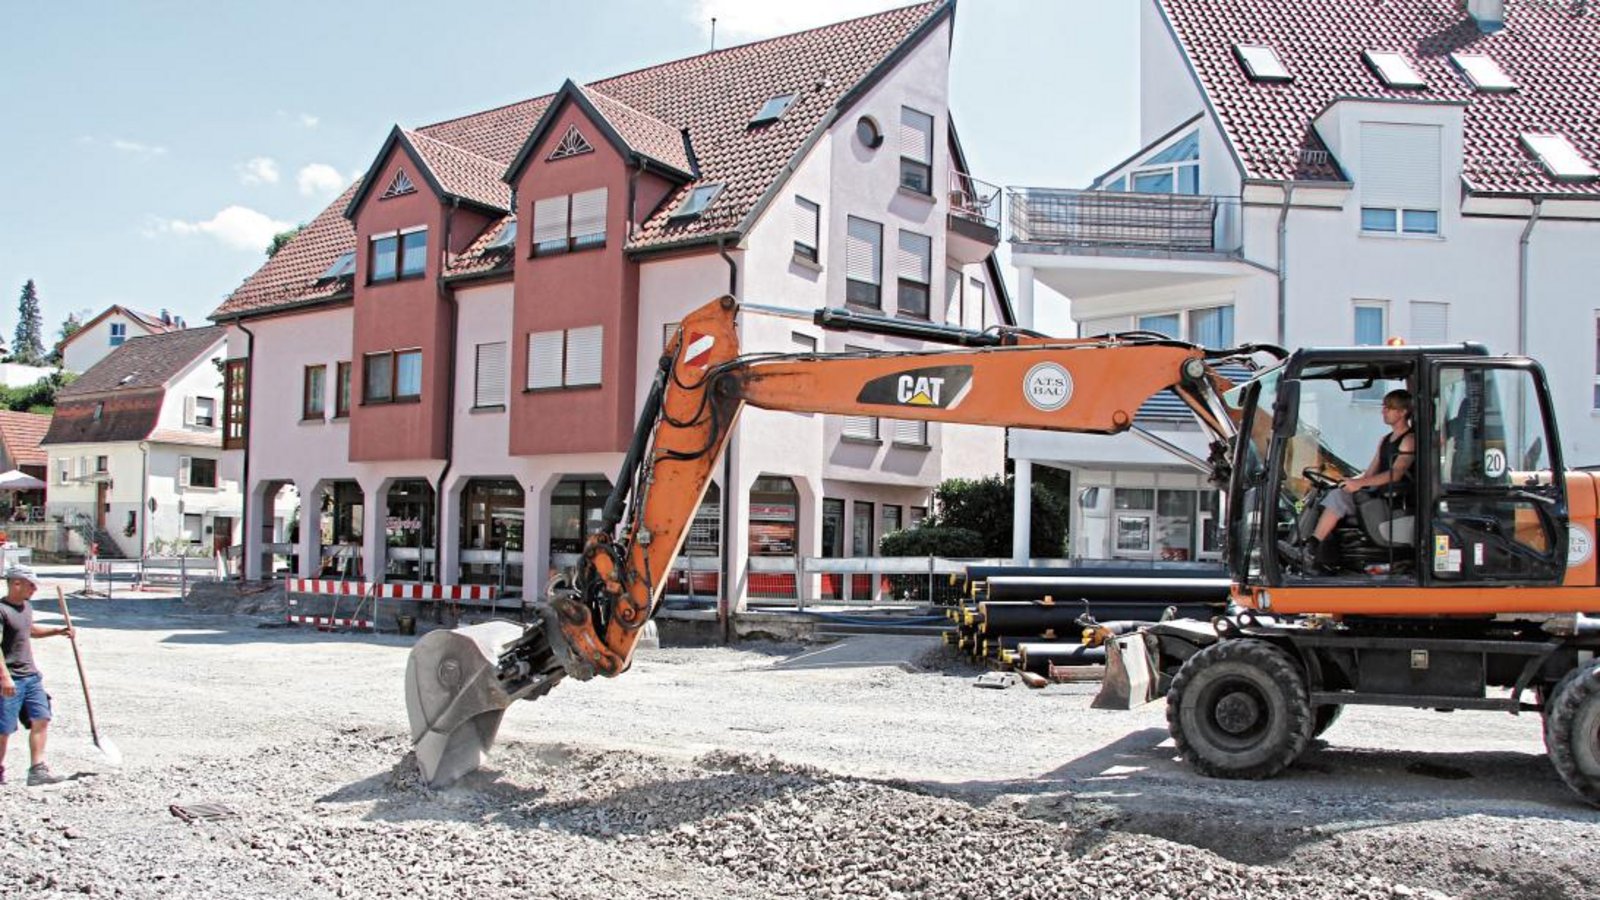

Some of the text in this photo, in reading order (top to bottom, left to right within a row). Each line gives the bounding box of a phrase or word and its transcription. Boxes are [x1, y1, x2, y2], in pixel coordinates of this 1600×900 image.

[897, 375, 945, 405] CAT
[1033, 387, 1064, 396] BAU
[1486, 454, 1501, 472] 20
